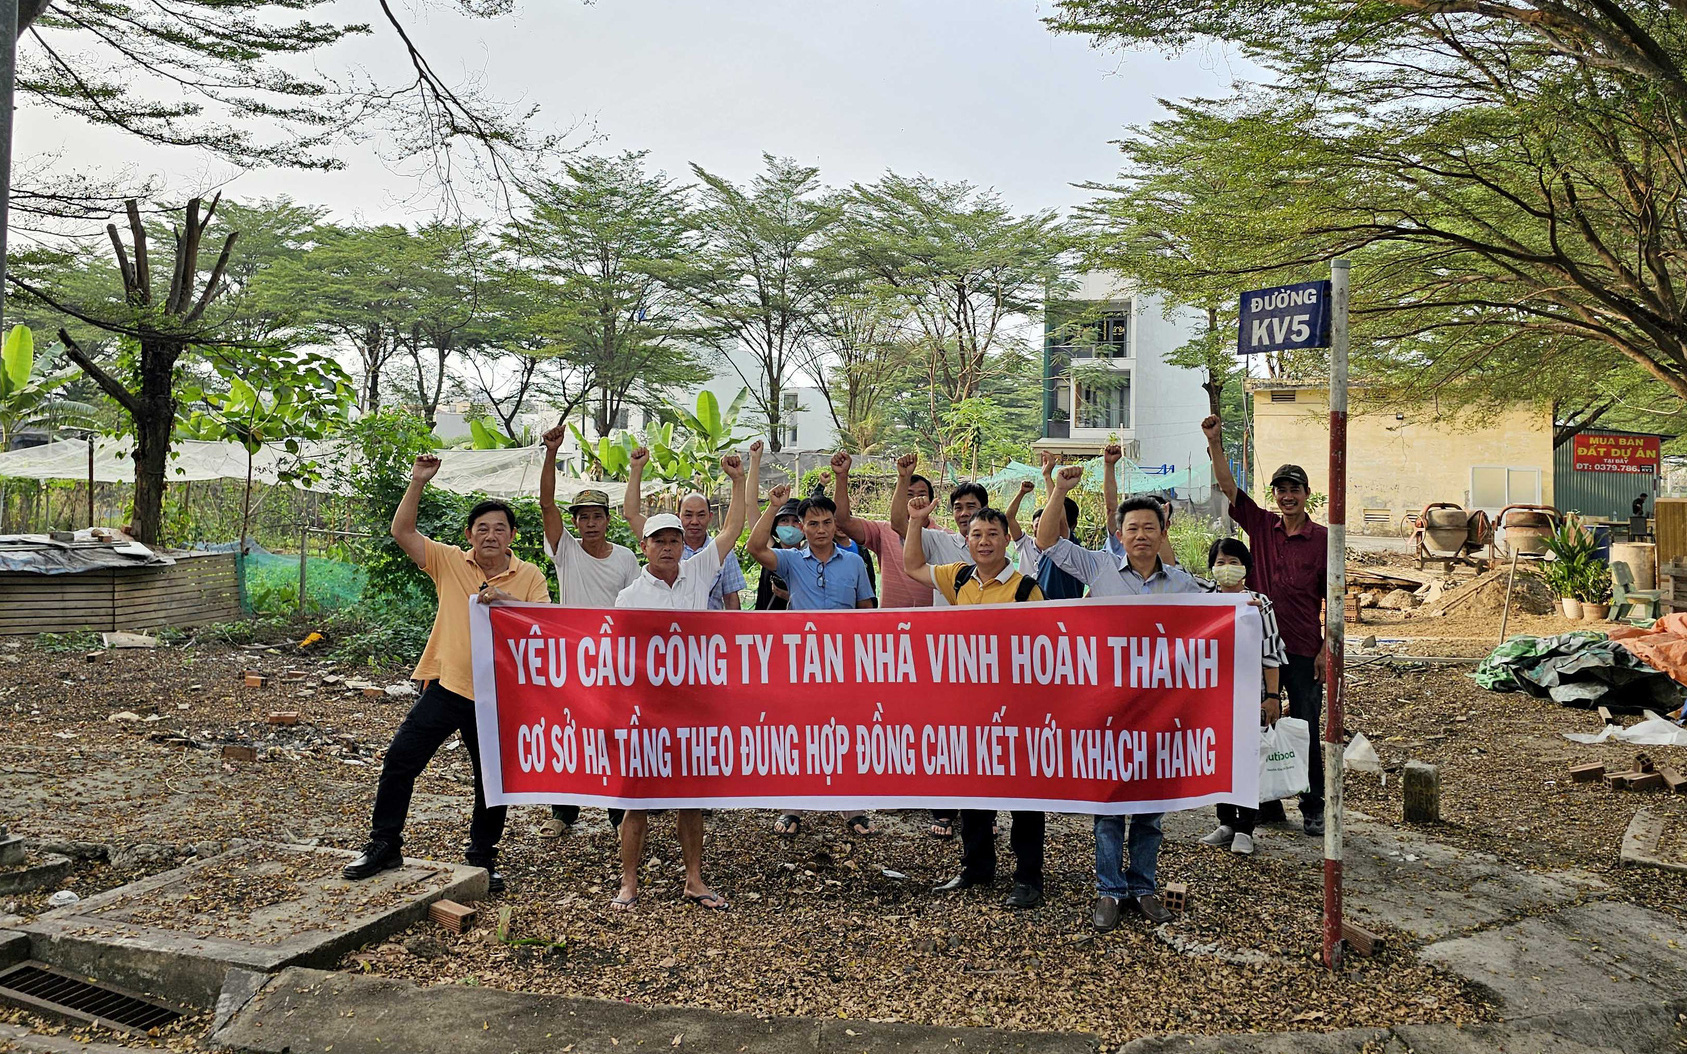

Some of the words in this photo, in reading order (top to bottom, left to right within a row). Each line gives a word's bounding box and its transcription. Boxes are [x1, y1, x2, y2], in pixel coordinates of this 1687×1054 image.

[1250, 288, 1317, 313] ĐƯỜNG
[1251, 314, 1310, 347] KV5
[1577, 445, 1607, 456] ĐẤT
[1611, 447, 1632, 460] DỰ
[1635, 447, 1656, 458] ÁN
[1589, 437, 1615, 445] MUA
[1619, 436, 1644, 446] BÁN
[1594, 463, 1640, 472] 0379.786.
[507, 624, 567, 688] YÊU
[577, 615, 636, 687] CẦU
[646, 622, 727, 686] CÔNG
[735, 634, 773, 684] TY
[782, 622, 844, 683] TÂN
[854, 622, 917, 684] NHÃ
[926, 634, 999, 684] VINH
[1010, 622, 1098, 686] HOÀN
[1107, 623, 1218, 689] THÀNH
[517, 717, 546, 773] CƠ
[551, 708, 577, 774] SỞ
[582, 727, 611, 786] HẠ
[614, 705, 672, 777] TẦNG
[676, 725, 734, 777] THEO
[740, 711, 800, 776] ĐÚNG
[805, 717, 850, 786] HỢP
[856, 702, 916, 776] ĐỒNG
[921, 724, 969, 775] CAM
[975, 706, 1018, 776] KẾT
[1025, 713, 1064, 778] VỚI
[1070, 716, 1148, 782] KHÁCH
[1156, 718, 1216, 779] HÀNG
